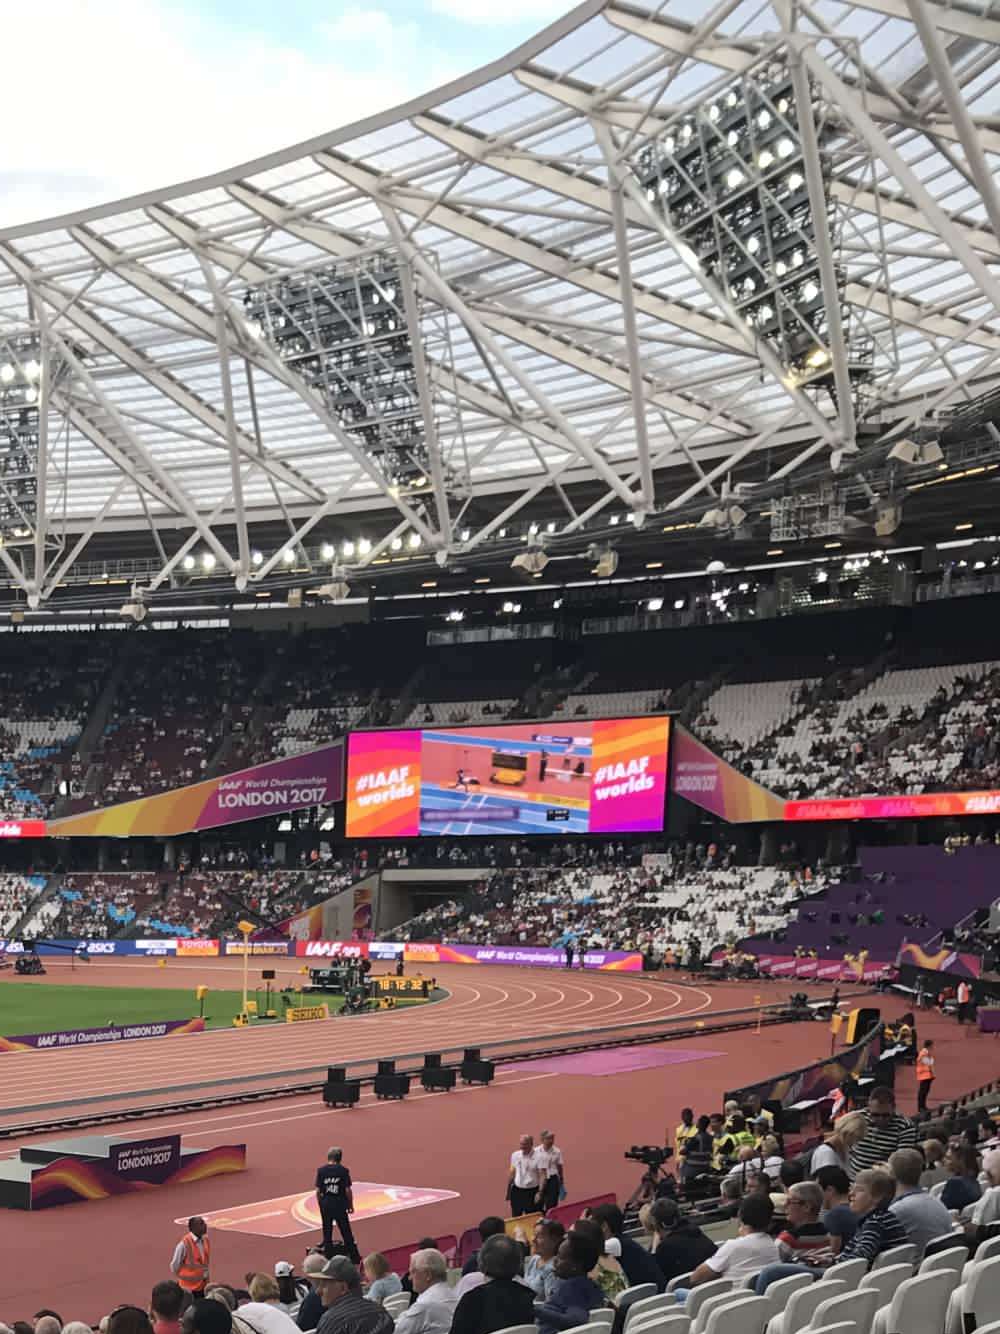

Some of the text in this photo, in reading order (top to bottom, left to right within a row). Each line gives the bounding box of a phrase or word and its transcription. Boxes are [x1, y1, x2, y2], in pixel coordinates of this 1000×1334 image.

[355, 765, 410, 792] #IAAF
[594, 756, 650, 785] #IAAF
[245, 779, 268, 789] World
[359, 783, 416, 807] worlds
[594, 773, 656, 801] worlds
[217, 787, 328, 809] LONDON 2017
[118, 1151, 171, 1171] LONDON 2017
